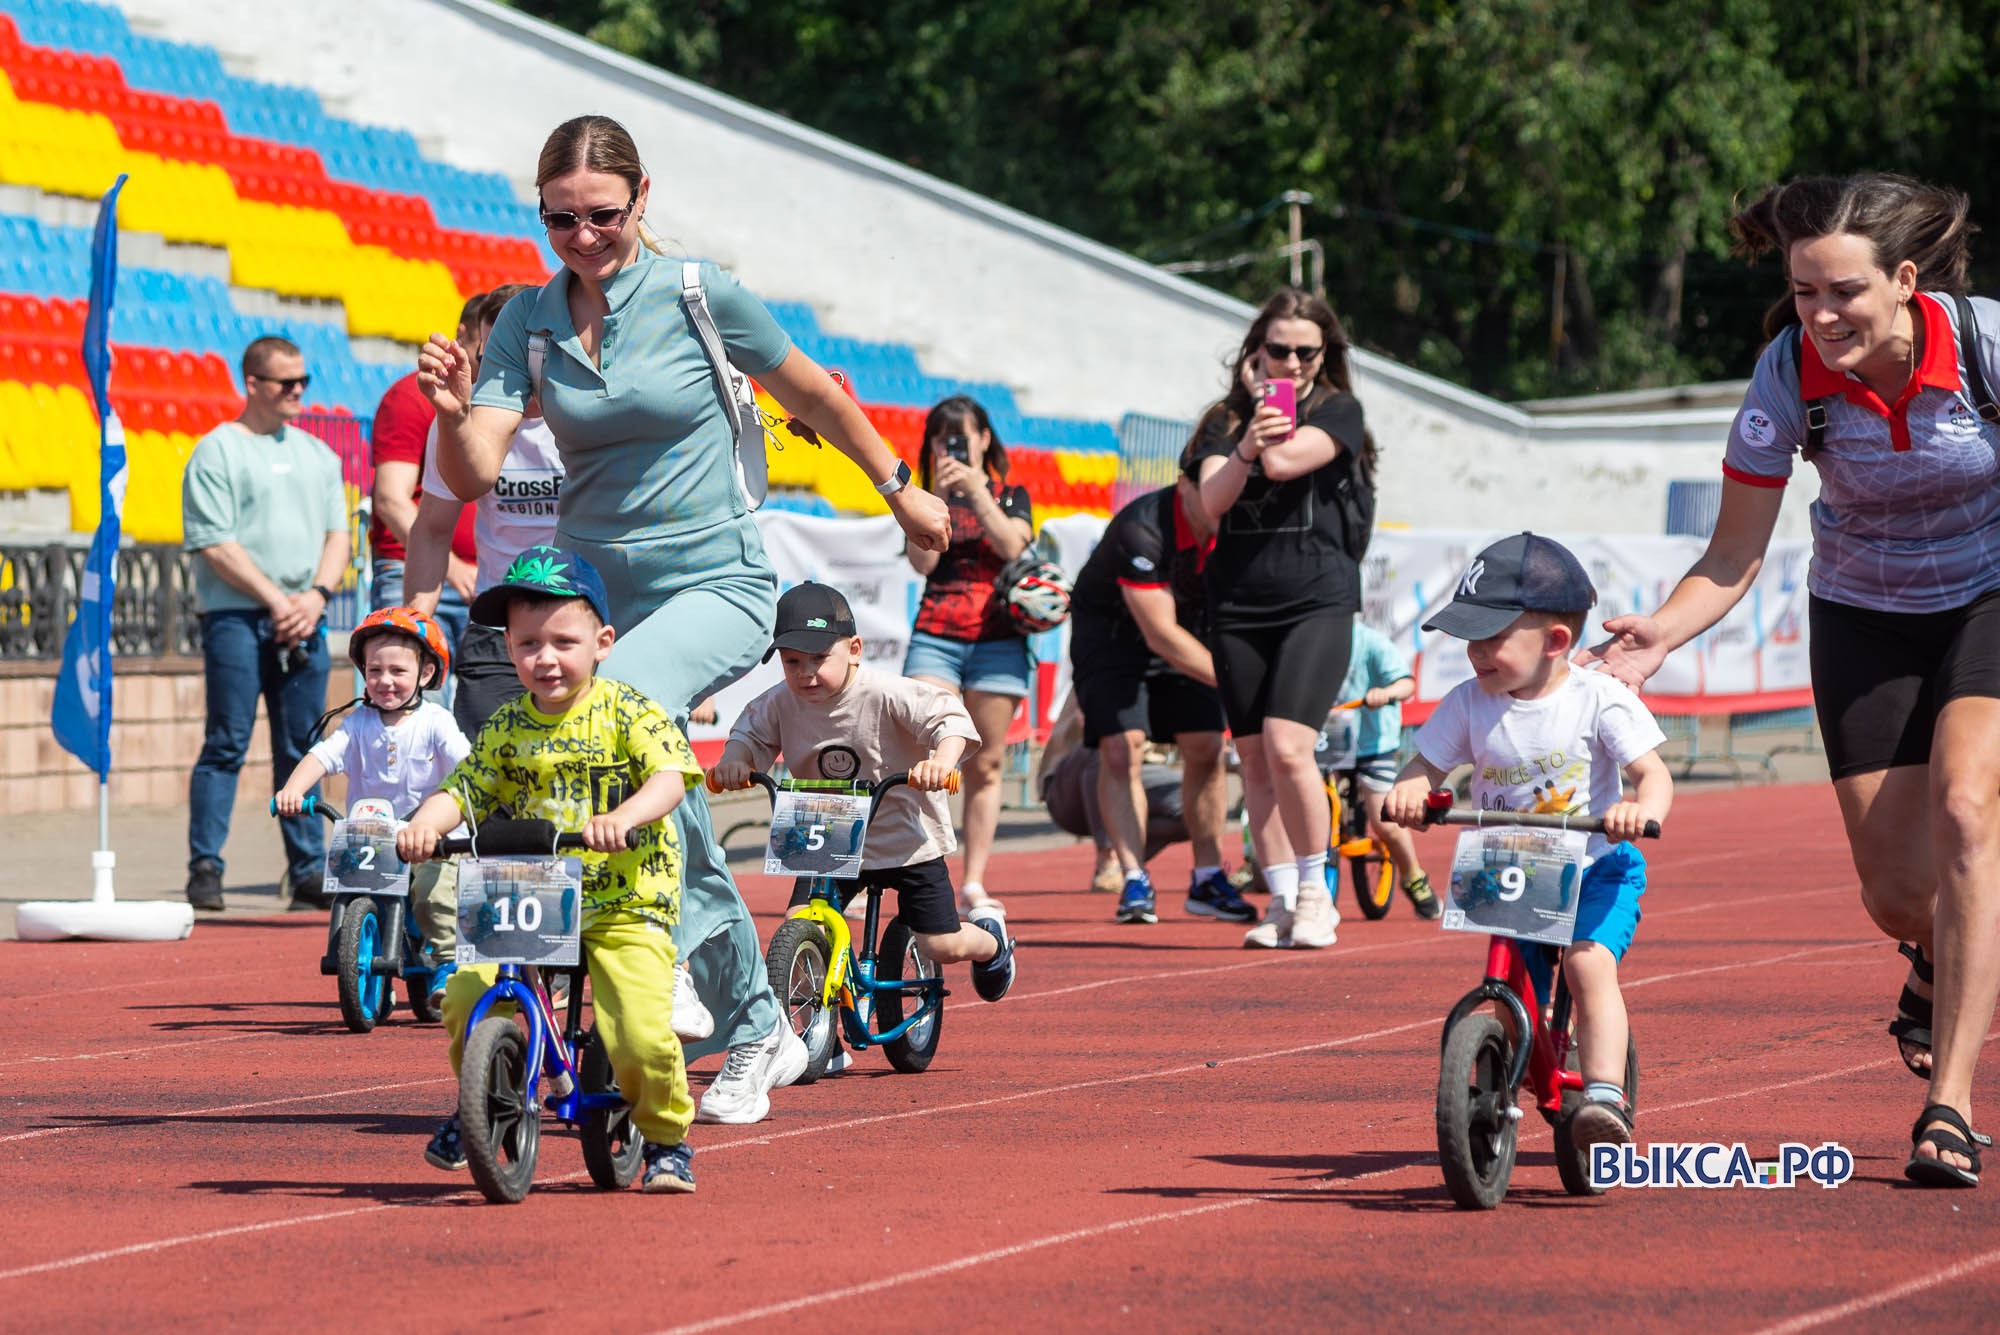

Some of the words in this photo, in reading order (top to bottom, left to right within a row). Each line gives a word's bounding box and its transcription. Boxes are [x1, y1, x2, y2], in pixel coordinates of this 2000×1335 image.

[496, 502, 560, 515] REGION
[1534, 750, 1567, 775] TO
[806, 825, 826, 850] 5
[358, 846, 375, 870] 2
[1499, 866, 1527, 902] 9
[493, 897, 543, 932] 10
